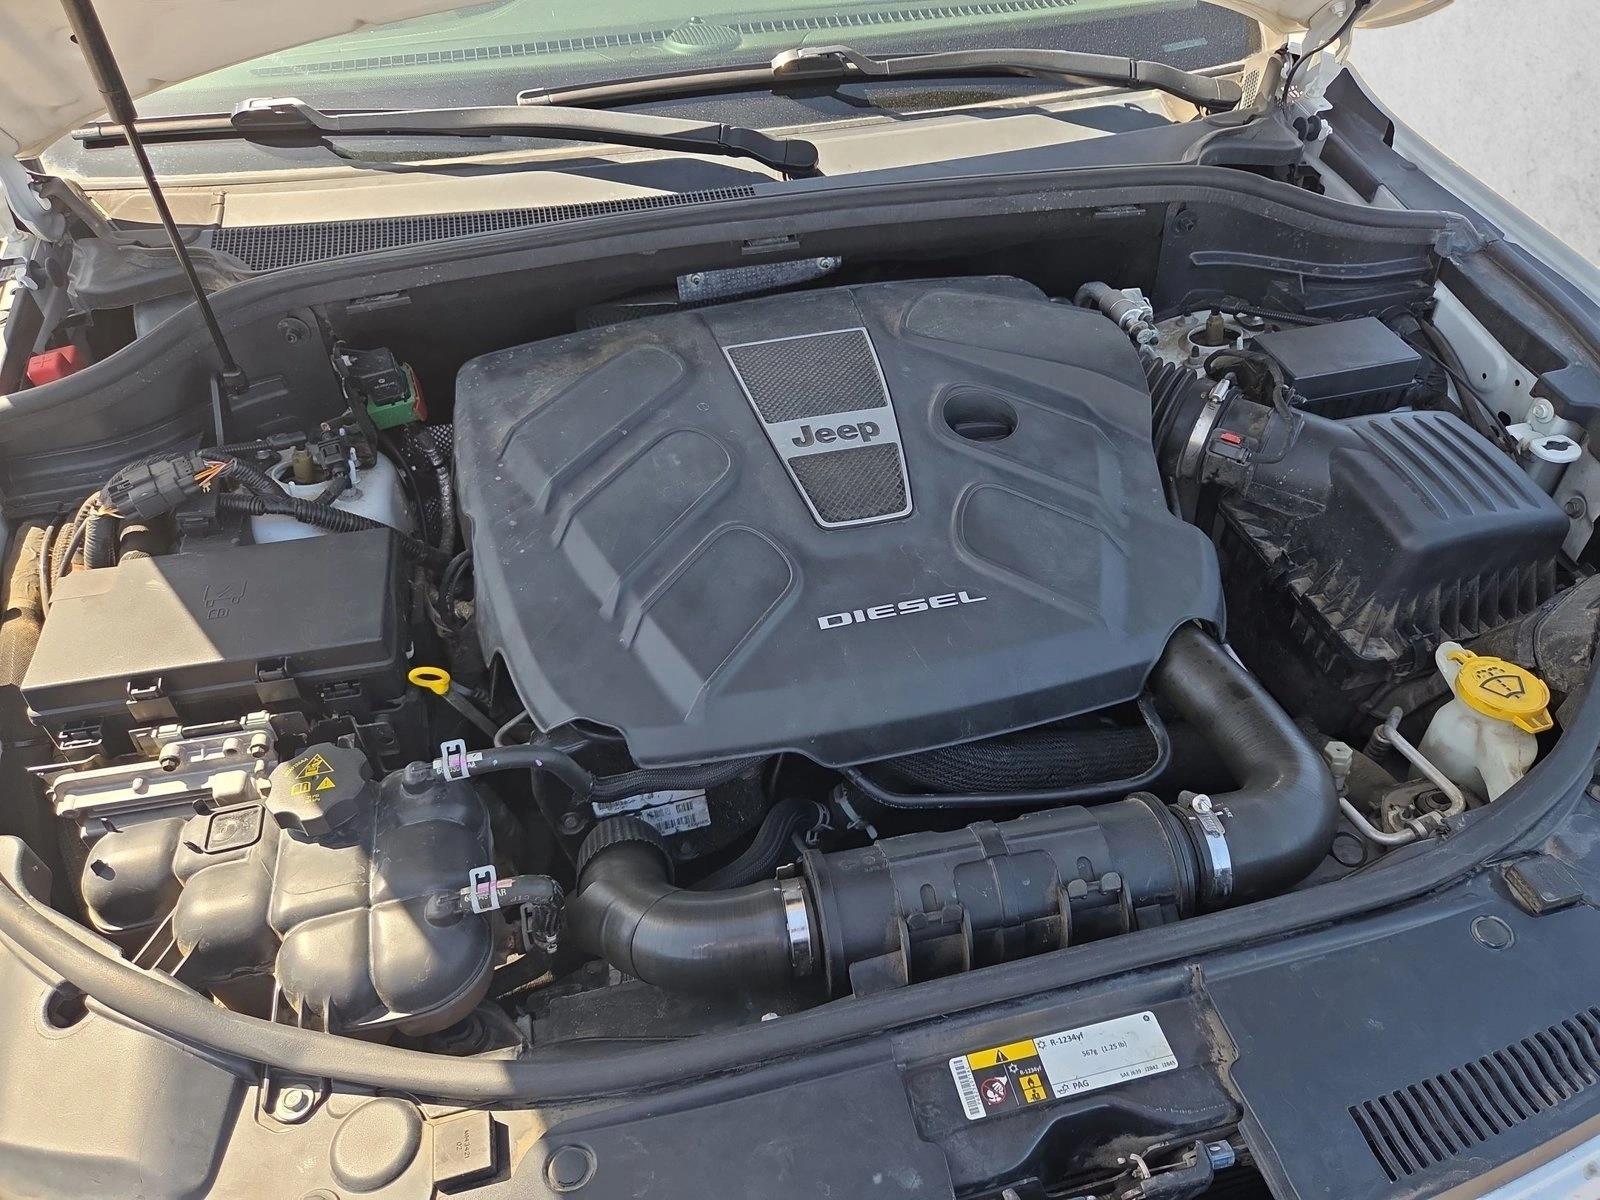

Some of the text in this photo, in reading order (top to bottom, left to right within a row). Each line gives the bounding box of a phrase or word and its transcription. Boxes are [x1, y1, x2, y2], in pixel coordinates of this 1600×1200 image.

[792, 421, 880, 447] Jeep
[817, 591, 987, 630] DIESEL
[1050, 1031, 1084, 1046] R-1234yf
[1082, 1040, 1128, 1057] 567g (1.25 lb)
[1072, 1079, 1090, 1090] PAG
